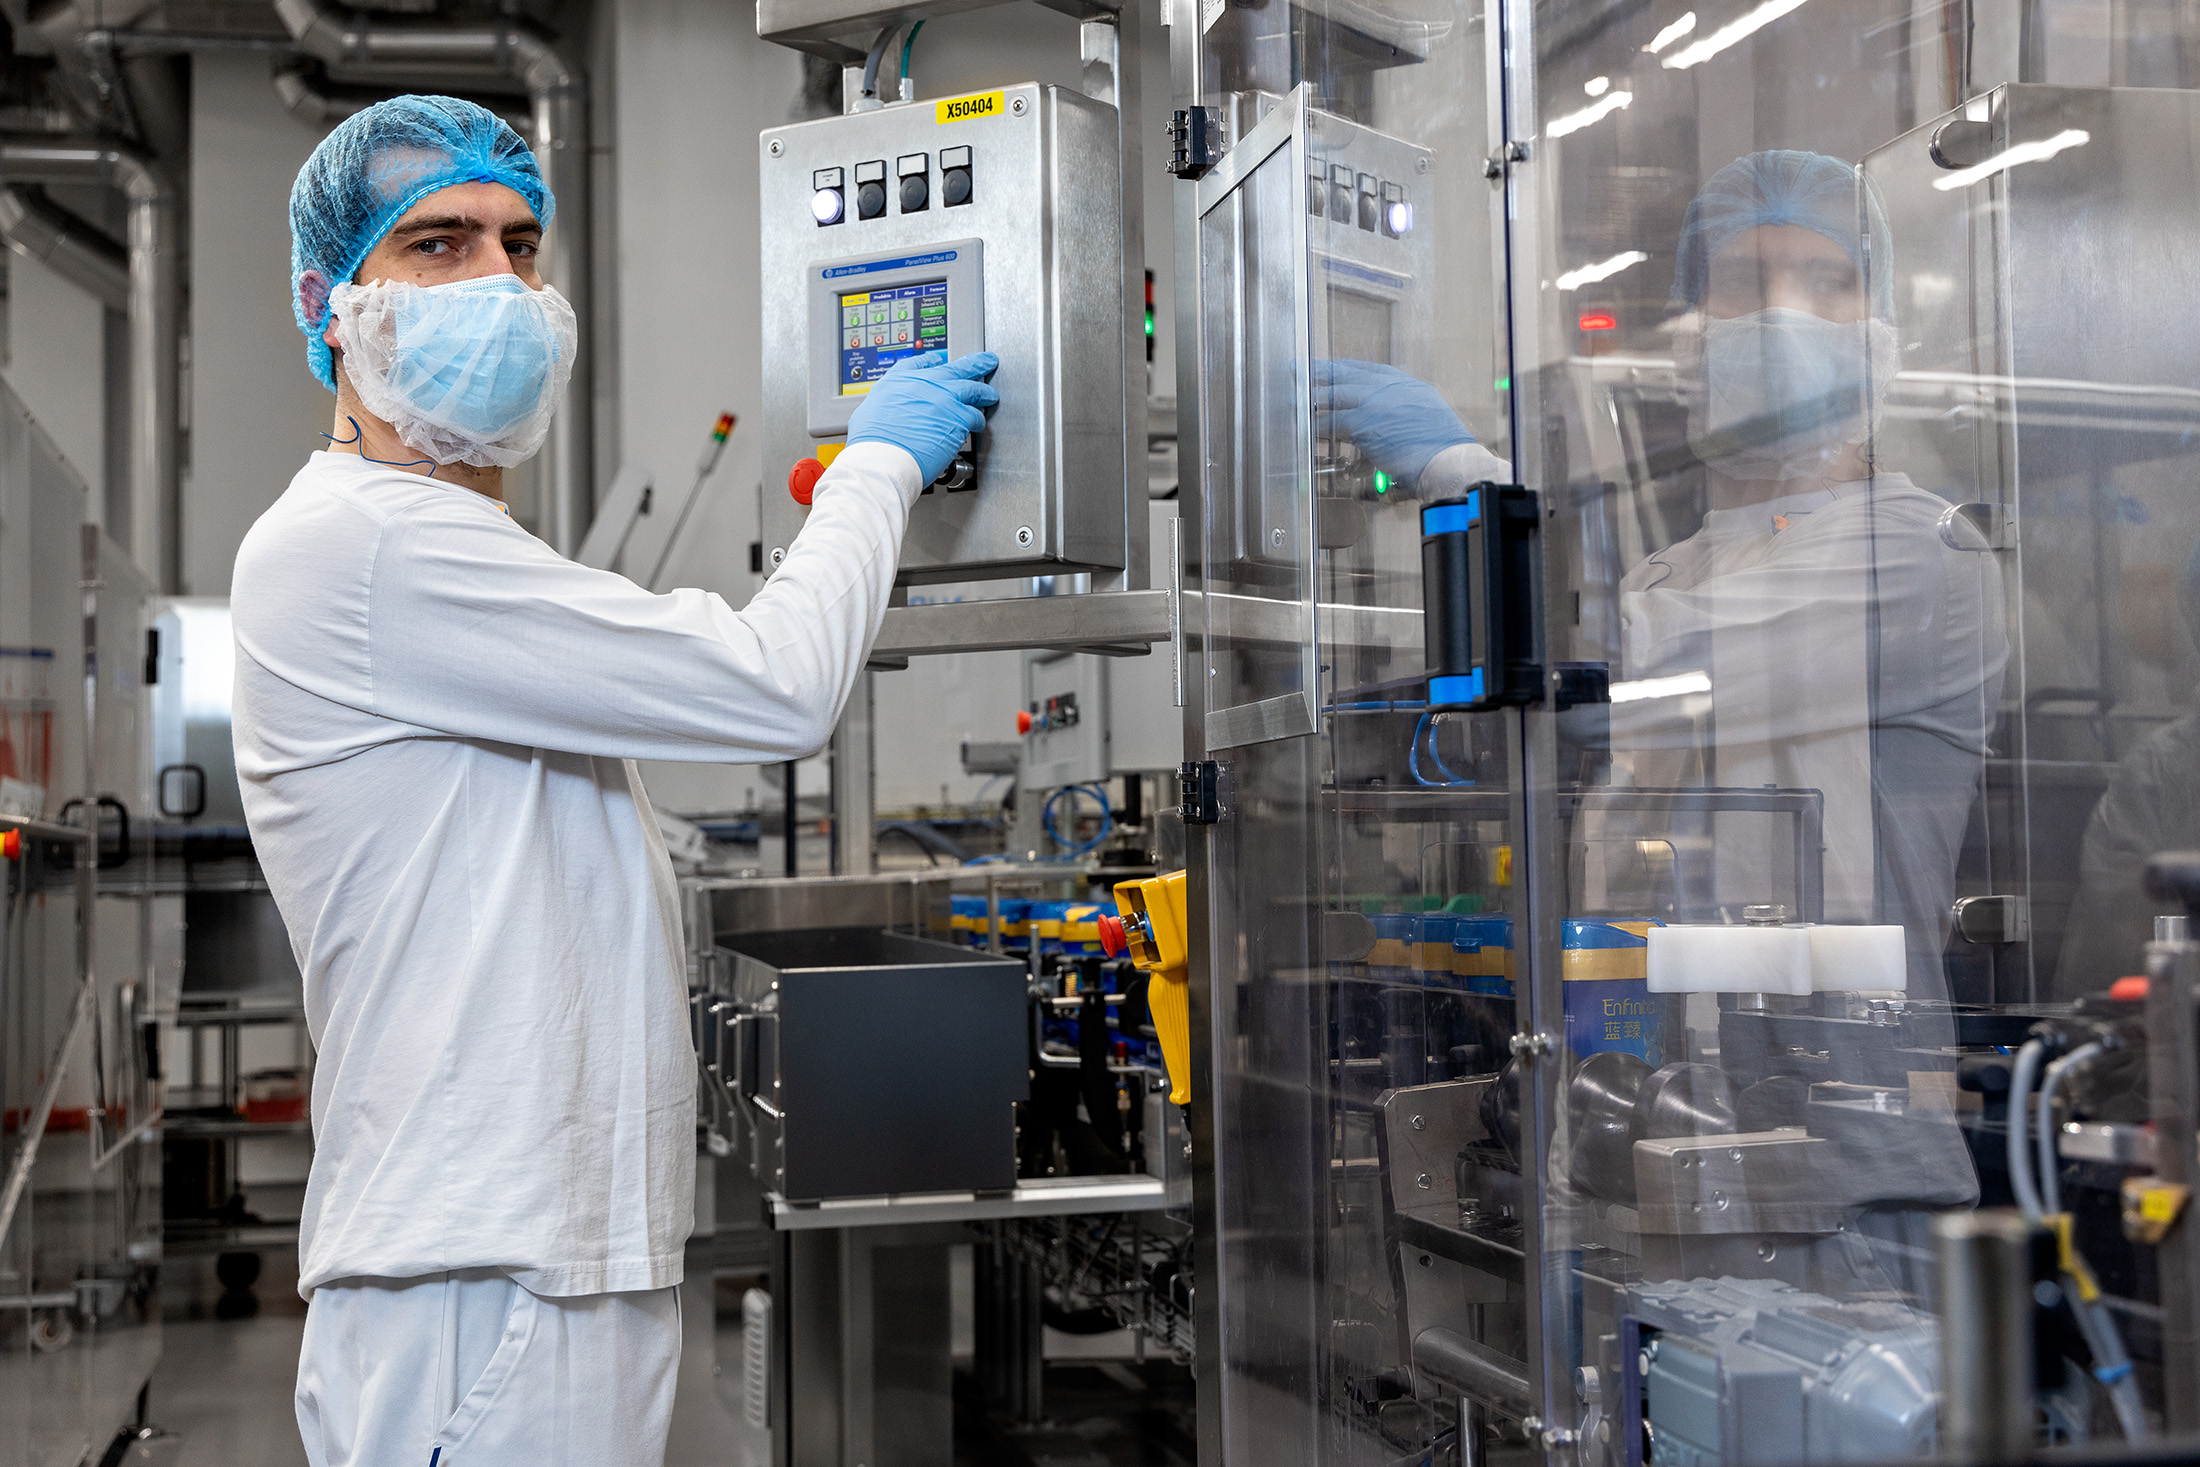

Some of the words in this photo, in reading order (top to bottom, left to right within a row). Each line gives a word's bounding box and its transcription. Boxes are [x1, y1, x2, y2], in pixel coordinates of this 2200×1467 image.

[947, 97, 993, 119] X50404
[932, 254, 945, 263] Plus
[835, 266, 867, 276] Allen-Bradley
